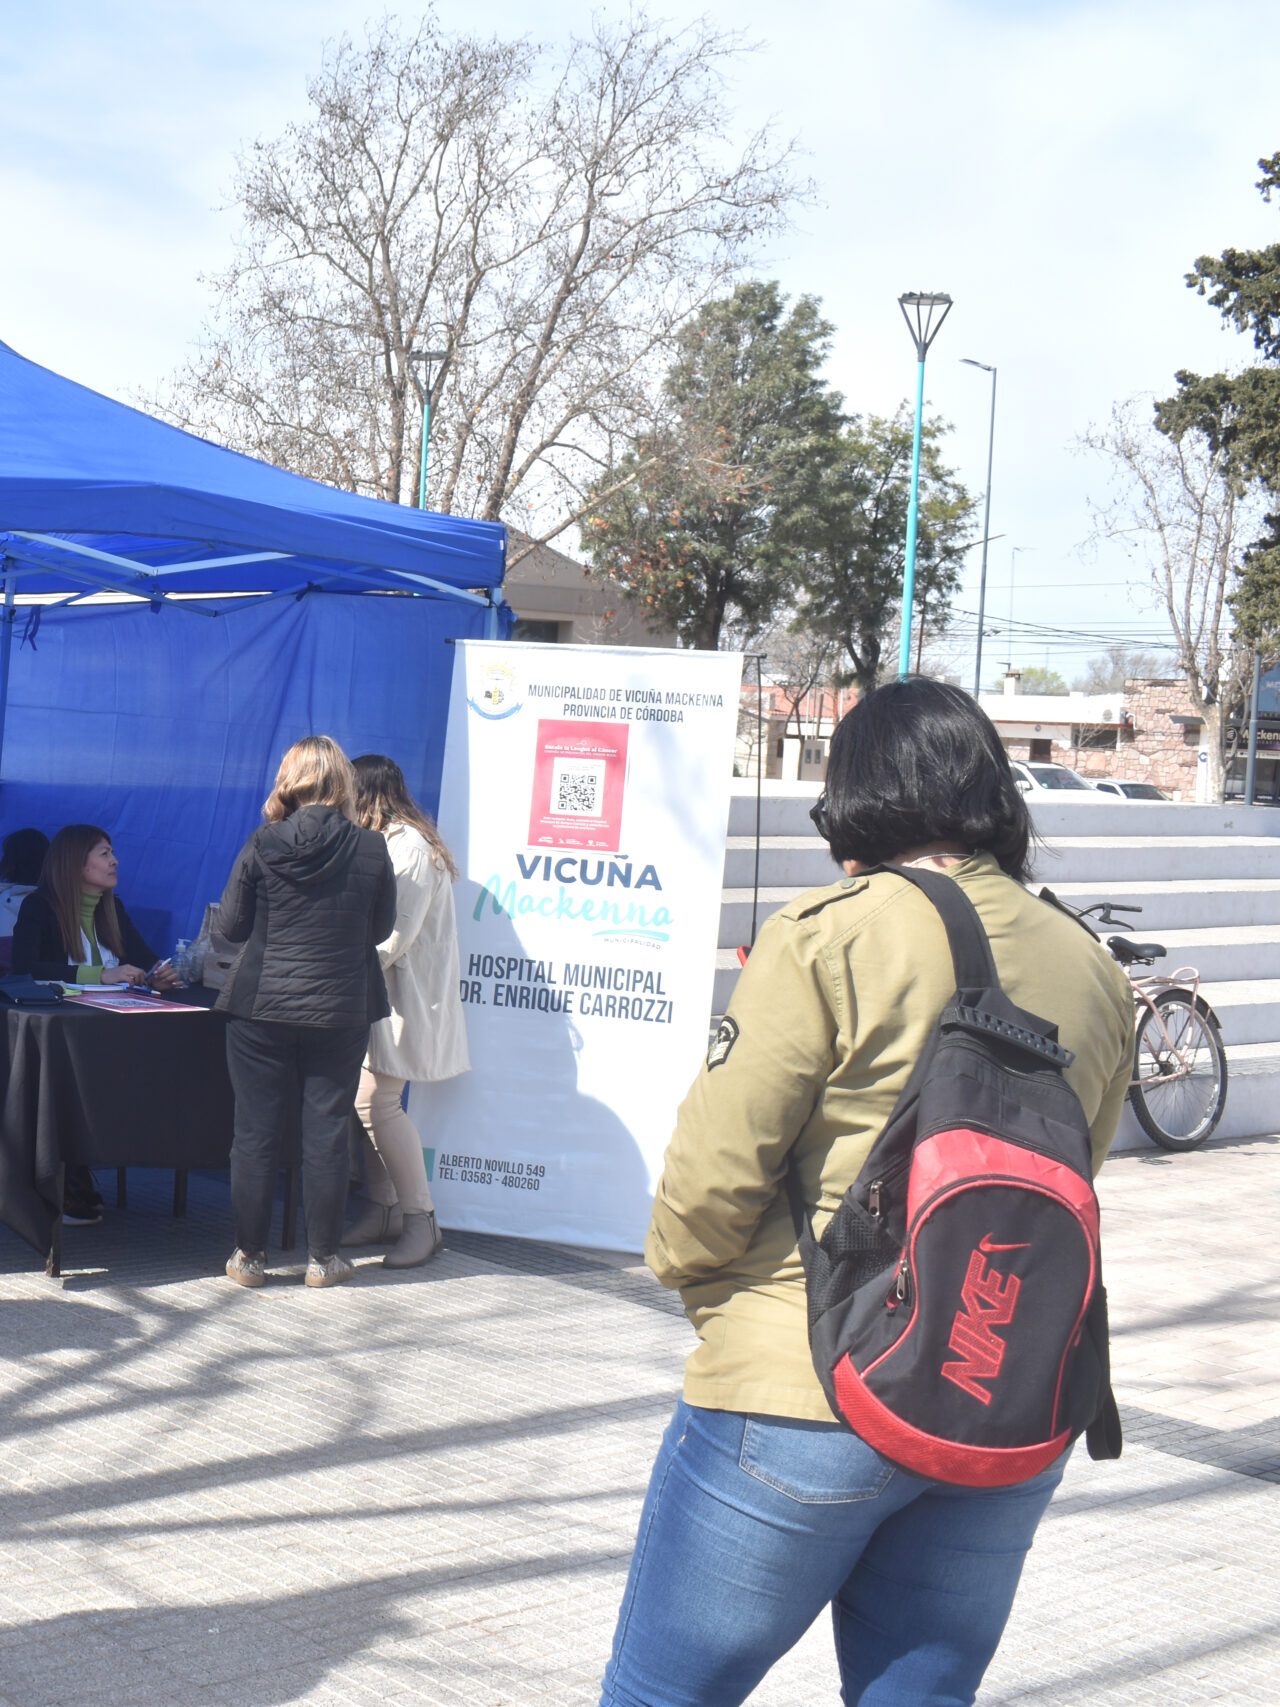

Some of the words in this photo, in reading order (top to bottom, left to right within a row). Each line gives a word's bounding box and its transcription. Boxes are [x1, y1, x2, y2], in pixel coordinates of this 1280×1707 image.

[528, 684, 606, 701] MUNICIPALIDAD
[609, 688, 623, 702] DE
[625, 688, 662, 704] VICUÑA
[665, 692, 724, 708] MACKENNA
[563, 703, 617, 719] PROVINCIA
[620, 707, 633, 720] DE
[635, 705, 684, 723] CÓRDOBA
[516, 853, 663, 891] VICUÑA
[473, 873, 675, 927] Mackenna
[468, 953, 557, 985] HOSPITAL
[563, 963, 666, 995] MUNICIPAL
[459, 979, 487, 1005] DR.
[493, 983, 575, 1014] ENRIQUE
[579, 992, 673, 1024] CARROZZI
[439, 1153, 481, 1170] ALBERTO
[484, 1159, 524, 1175] NOVILLO
[526, 1164, 545, 1178] 549
[439, 1166, 459, 1181] TEL:
[461, 1170, 493, 1185] 03583
[501, 1175, 540, 1191] 480260
[940, 1248, 1022, 1406] NIKE
